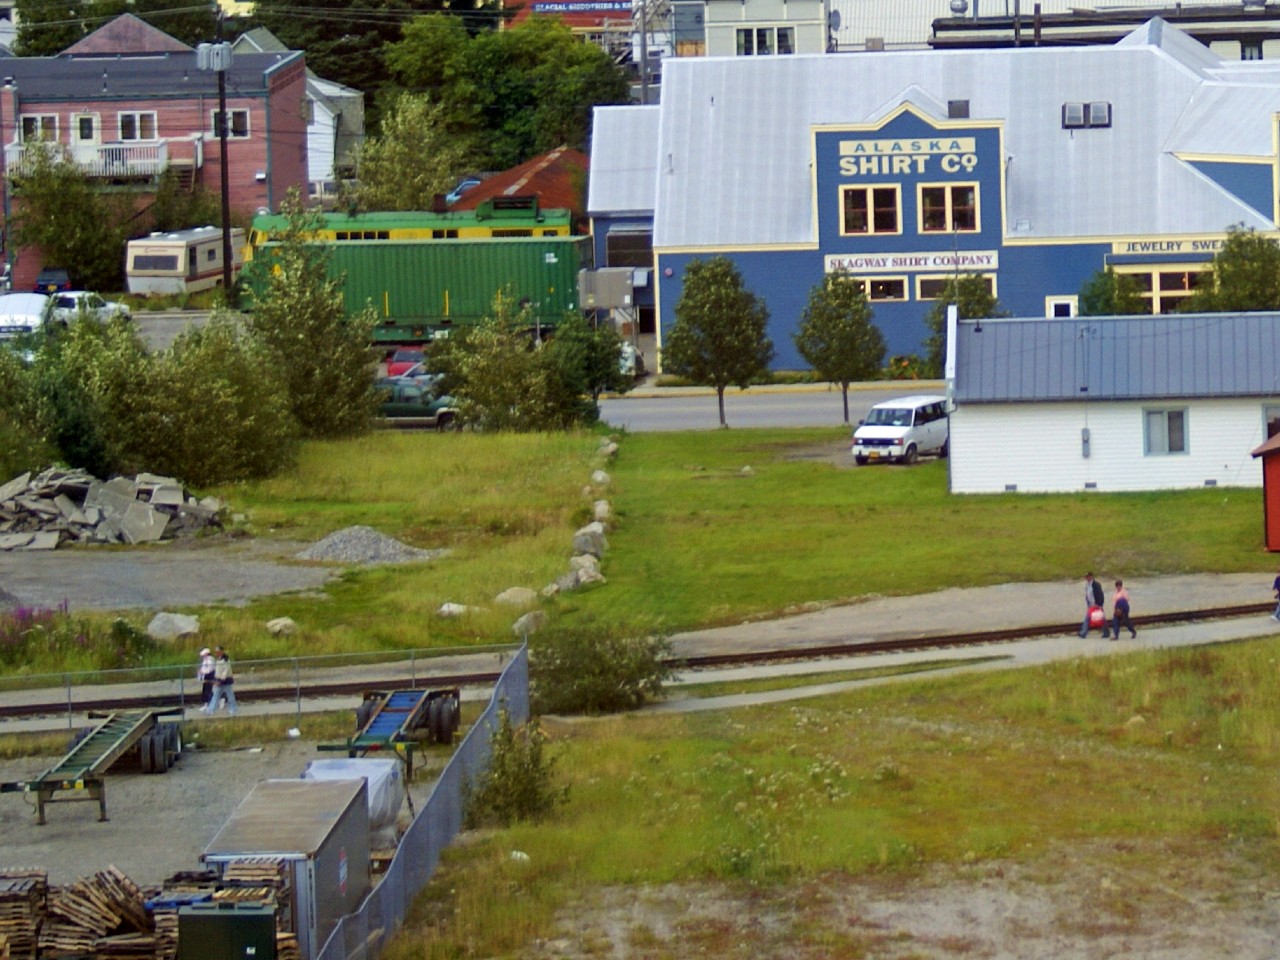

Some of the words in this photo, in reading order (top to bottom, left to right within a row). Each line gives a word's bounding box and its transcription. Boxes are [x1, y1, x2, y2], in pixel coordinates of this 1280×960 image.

[854, 140, 962, 153] ALASKA
[839, 155, 930, 176] SHIRT
[1127, 241, 1182, 252] JEWELRY
[830, 257, 889, 269] SKAGWAY
[892, 256, 930, 267] SHIRT
[933, 254, 993, 266] COMPANY
